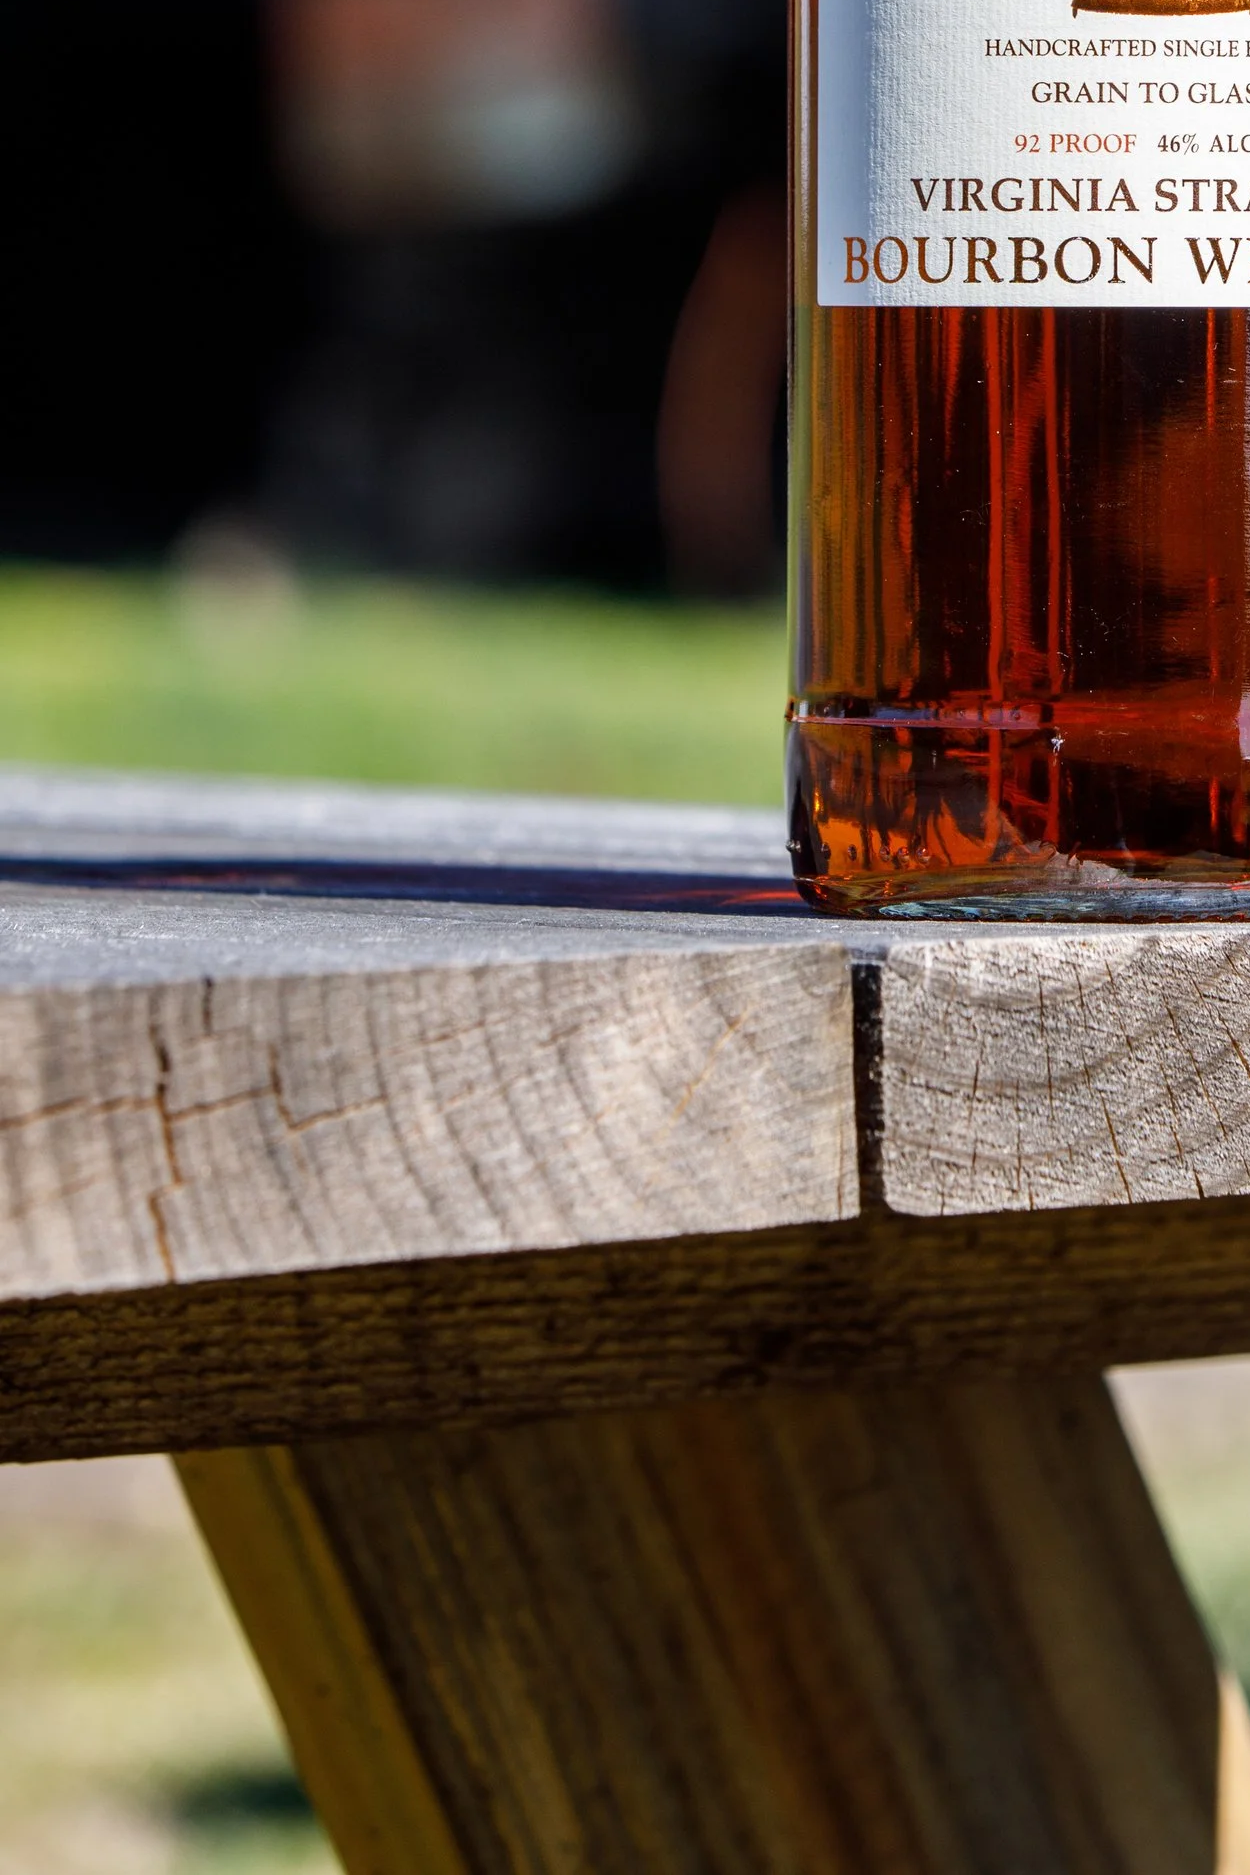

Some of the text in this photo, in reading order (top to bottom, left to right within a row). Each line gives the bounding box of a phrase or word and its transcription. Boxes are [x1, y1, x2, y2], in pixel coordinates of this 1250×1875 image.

[984, 38, 1157, 57] HANDCRAFTED
[1163, 39, 1240, 58] SINGLE
[1031, 81, 1130, 104] GRAIN
[1138, 81, 1180, 104] TO
[1014, 134, 1041, 154] 92
[1048, 133, 1137, 154] PROOF
[1157, 133, 1200, 156] 46%
[909, 177, 1141, 213] VIRGINIA
[843, 236, 1159, 285] BOURBON
